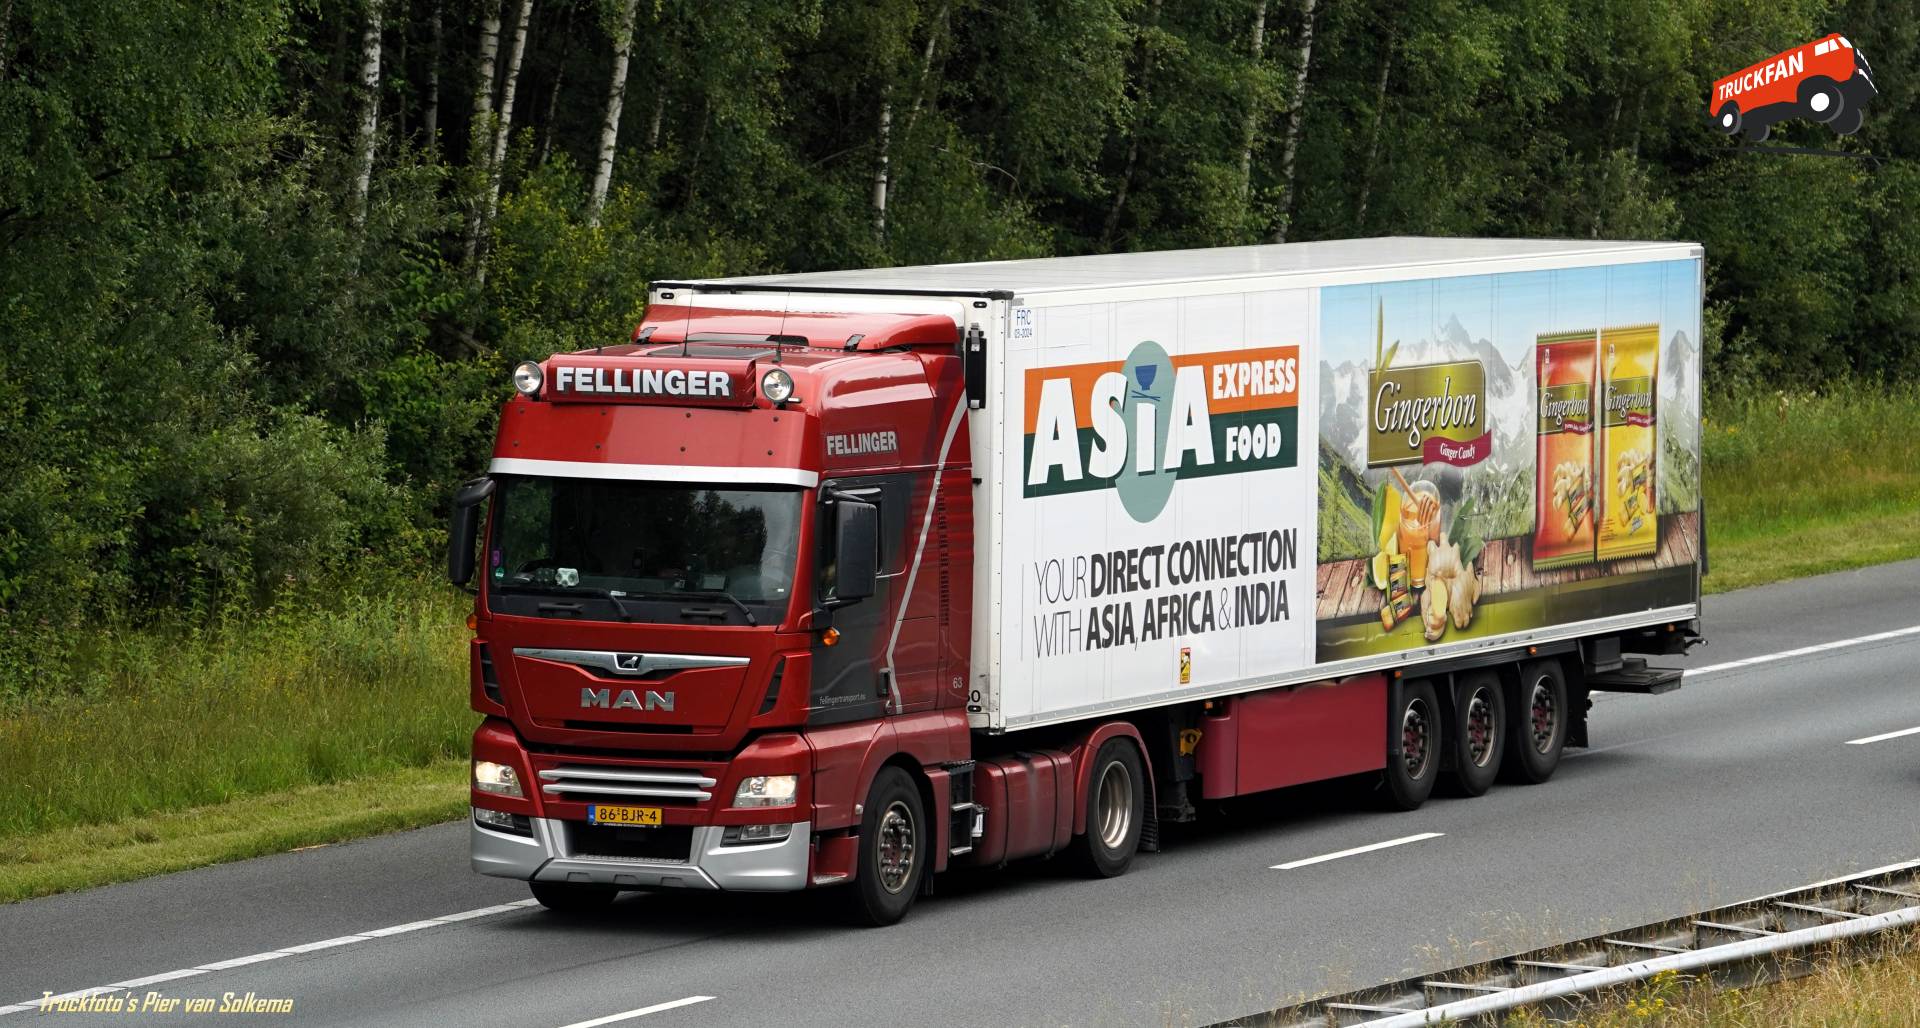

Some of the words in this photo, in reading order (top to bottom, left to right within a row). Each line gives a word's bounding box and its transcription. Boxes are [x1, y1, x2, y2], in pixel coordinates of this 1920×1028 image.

[1016, 309, 1032, 327] FRC
[556, 367, 730, 397] FELLINGER
[1212, 358, 1296, 400] EXPRESS
[1375, 376, 1476, 448] Gingerbon
[1540, 391, 1588, 425] Gingerbon
[1604, 383, 1652, 418] Gingerbon
[826, 431, 898, 456] FELLINGER
[1225, 422, 1282, 463] FOOD
[1440, 443, 1458, 461] Ginger
[1459, 445, 1476, 460] Candy
[1034, 555, 1088, 605] YOUR
[1090, 545, 1164, 598] DIRECT
[1167, 528, 1297, 586] CONNECTION
[1033, 608, 1083, 658] WITH
[1086, 600, 1140, 651] ASIA,
[1141, 590, 1216, 642] AFRICA
[1218, 587, 1232, 630] &
[1234, 579, 1290, 628] INDIA
[581, 688, 675, 712] MAN
[952, 677, 963, 689] 63
